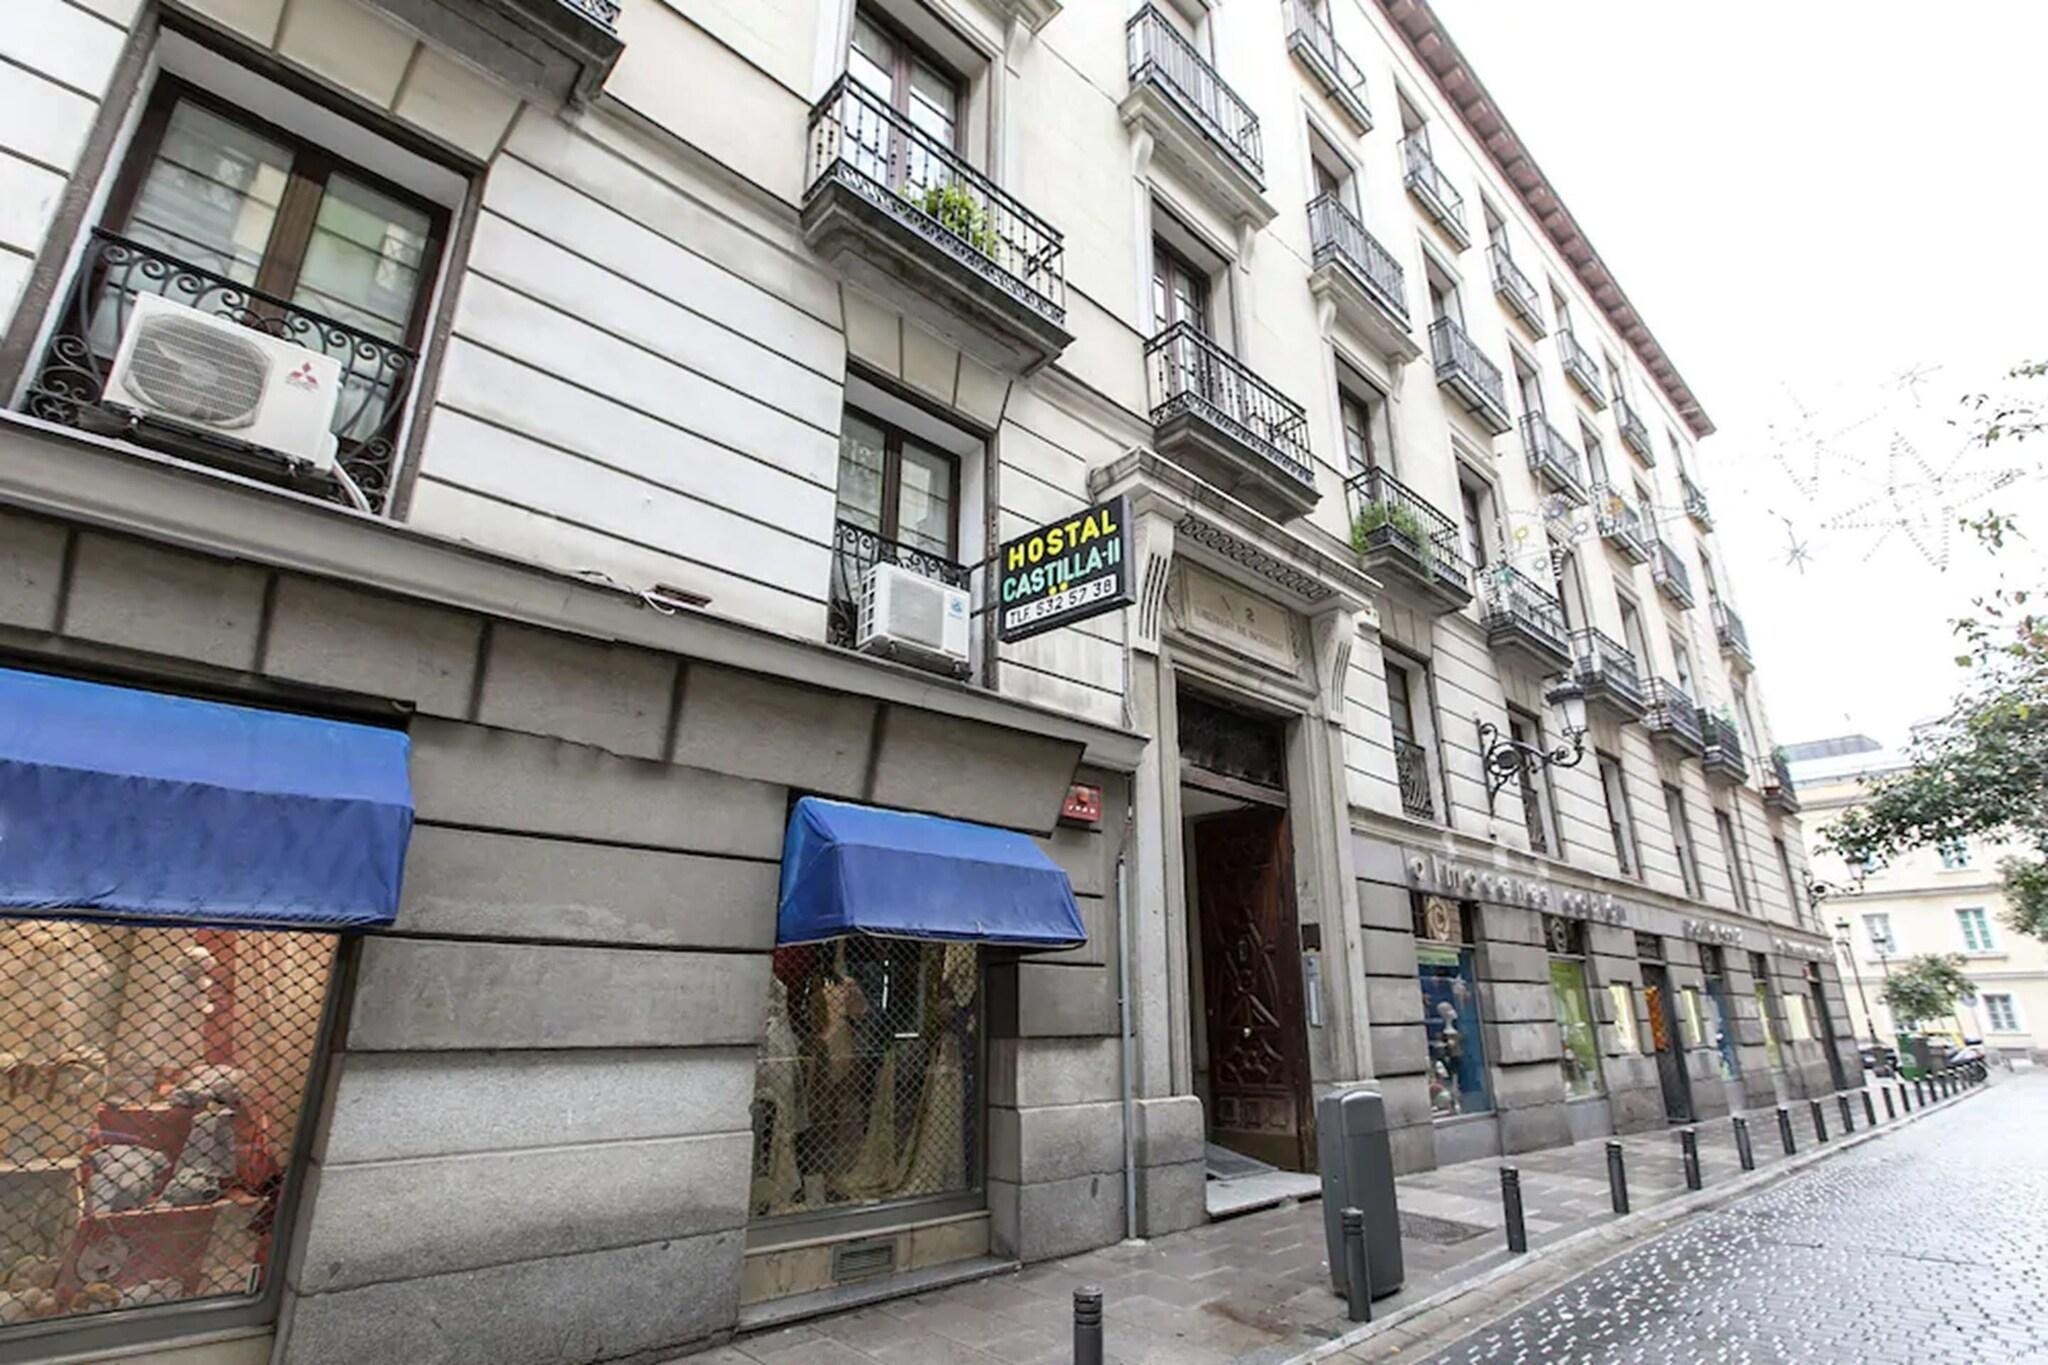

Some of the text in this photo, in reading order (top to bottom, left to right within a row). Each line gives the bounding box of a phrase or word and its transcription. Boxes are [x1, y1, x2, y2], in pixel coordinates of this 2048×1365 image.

[1002, 537, 1121, 602] CASTILLA-II
[1008, 509, 1117, 571] HOSTAL
[1036, 596, 1063, 616] 532
[1069, 587, 1087, 605] 57
[1093, 579, 1112, 597] 38
